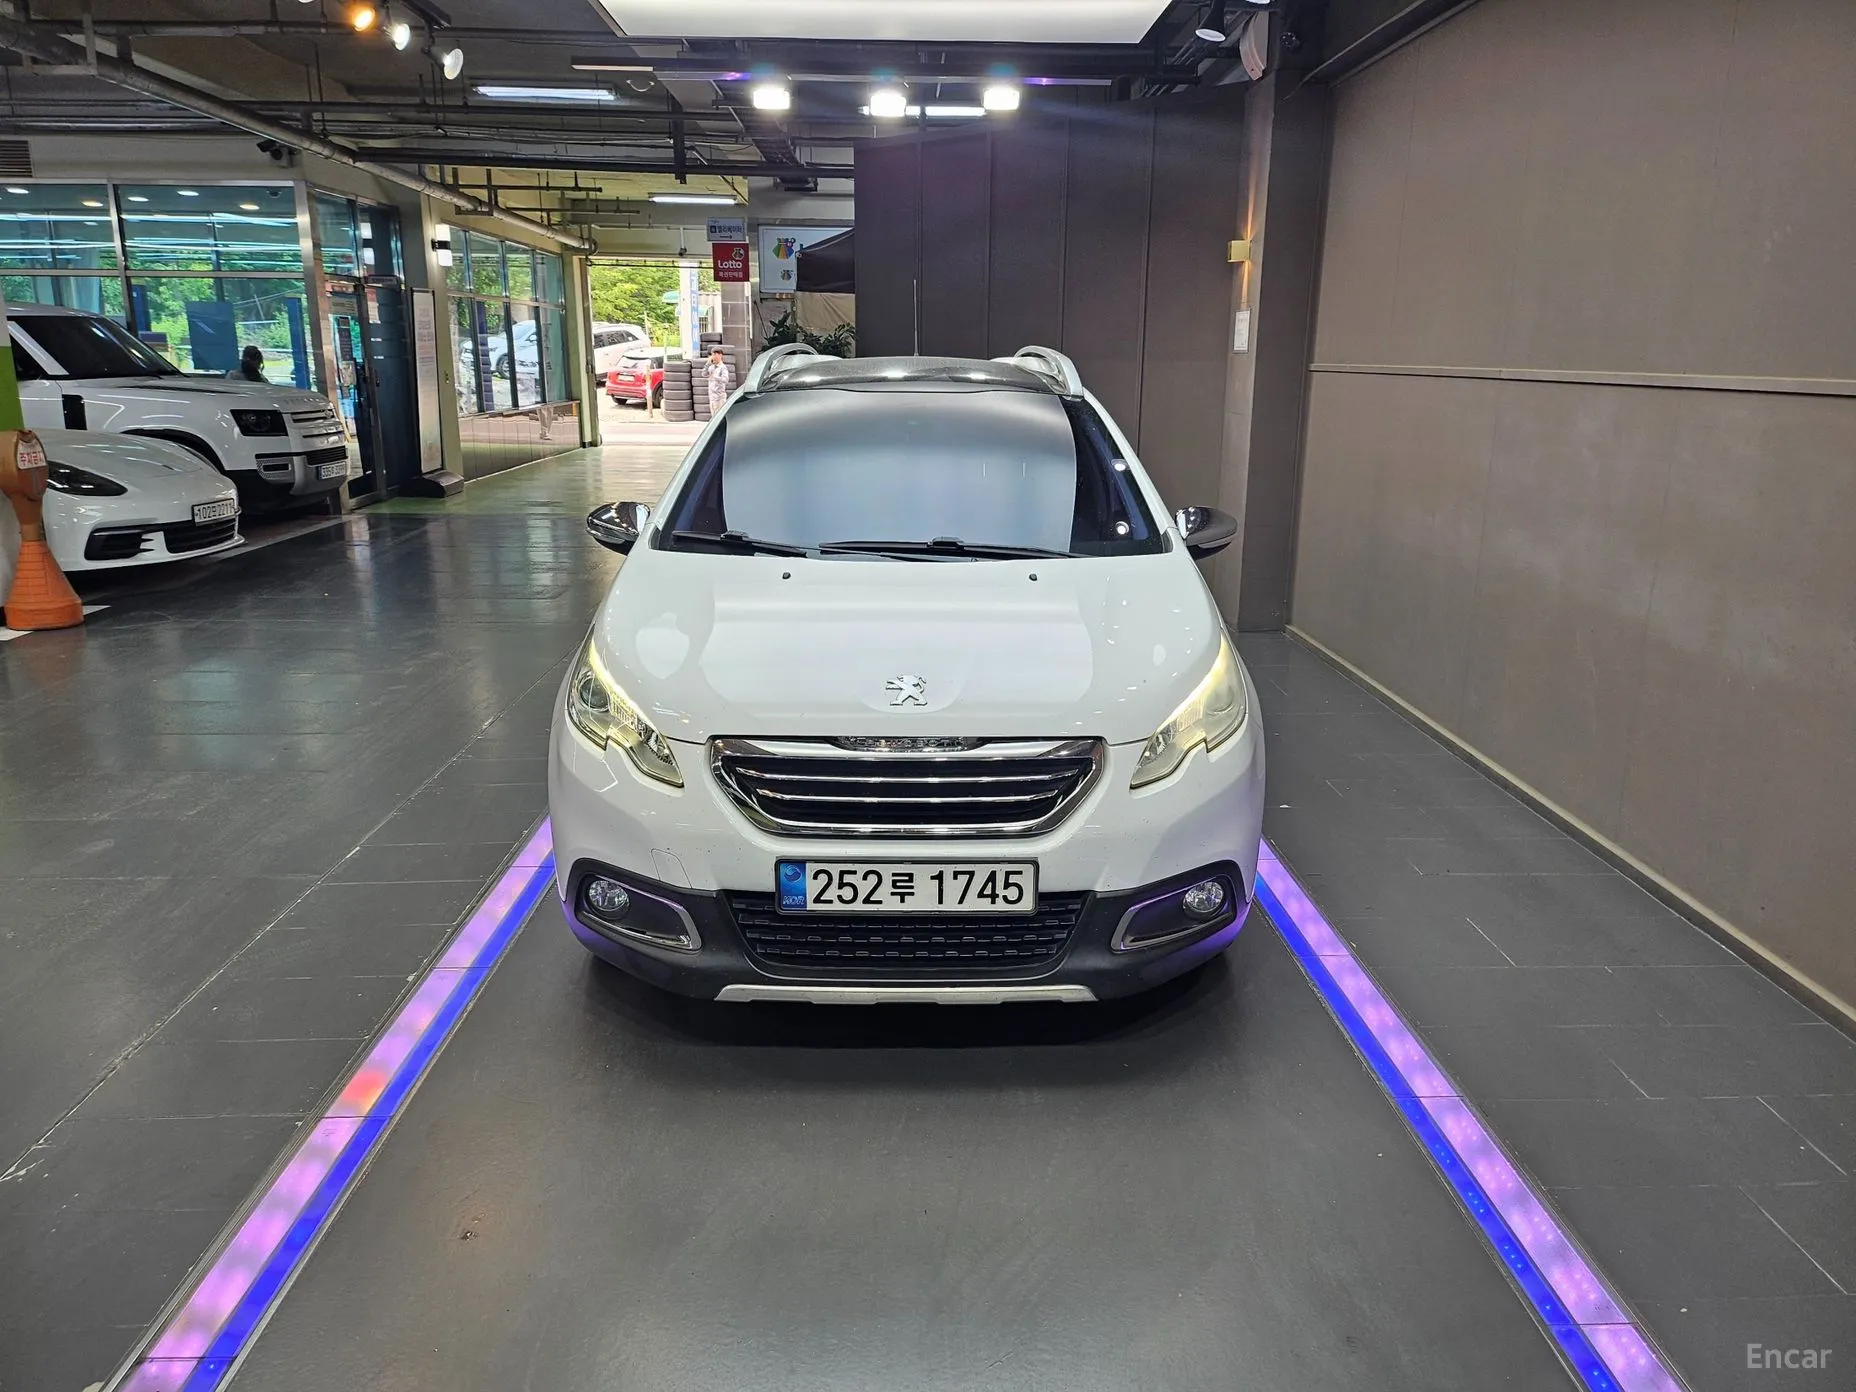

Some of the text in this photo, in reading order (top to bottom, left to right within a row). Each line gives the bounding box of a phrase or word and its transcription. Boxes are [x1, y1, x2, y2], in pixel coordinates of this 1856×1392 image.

[718, 260, 742, 268] Lotto
[812, 868, 1024, 905] 252루 1745
[783, 895, 805, 905] KOR
